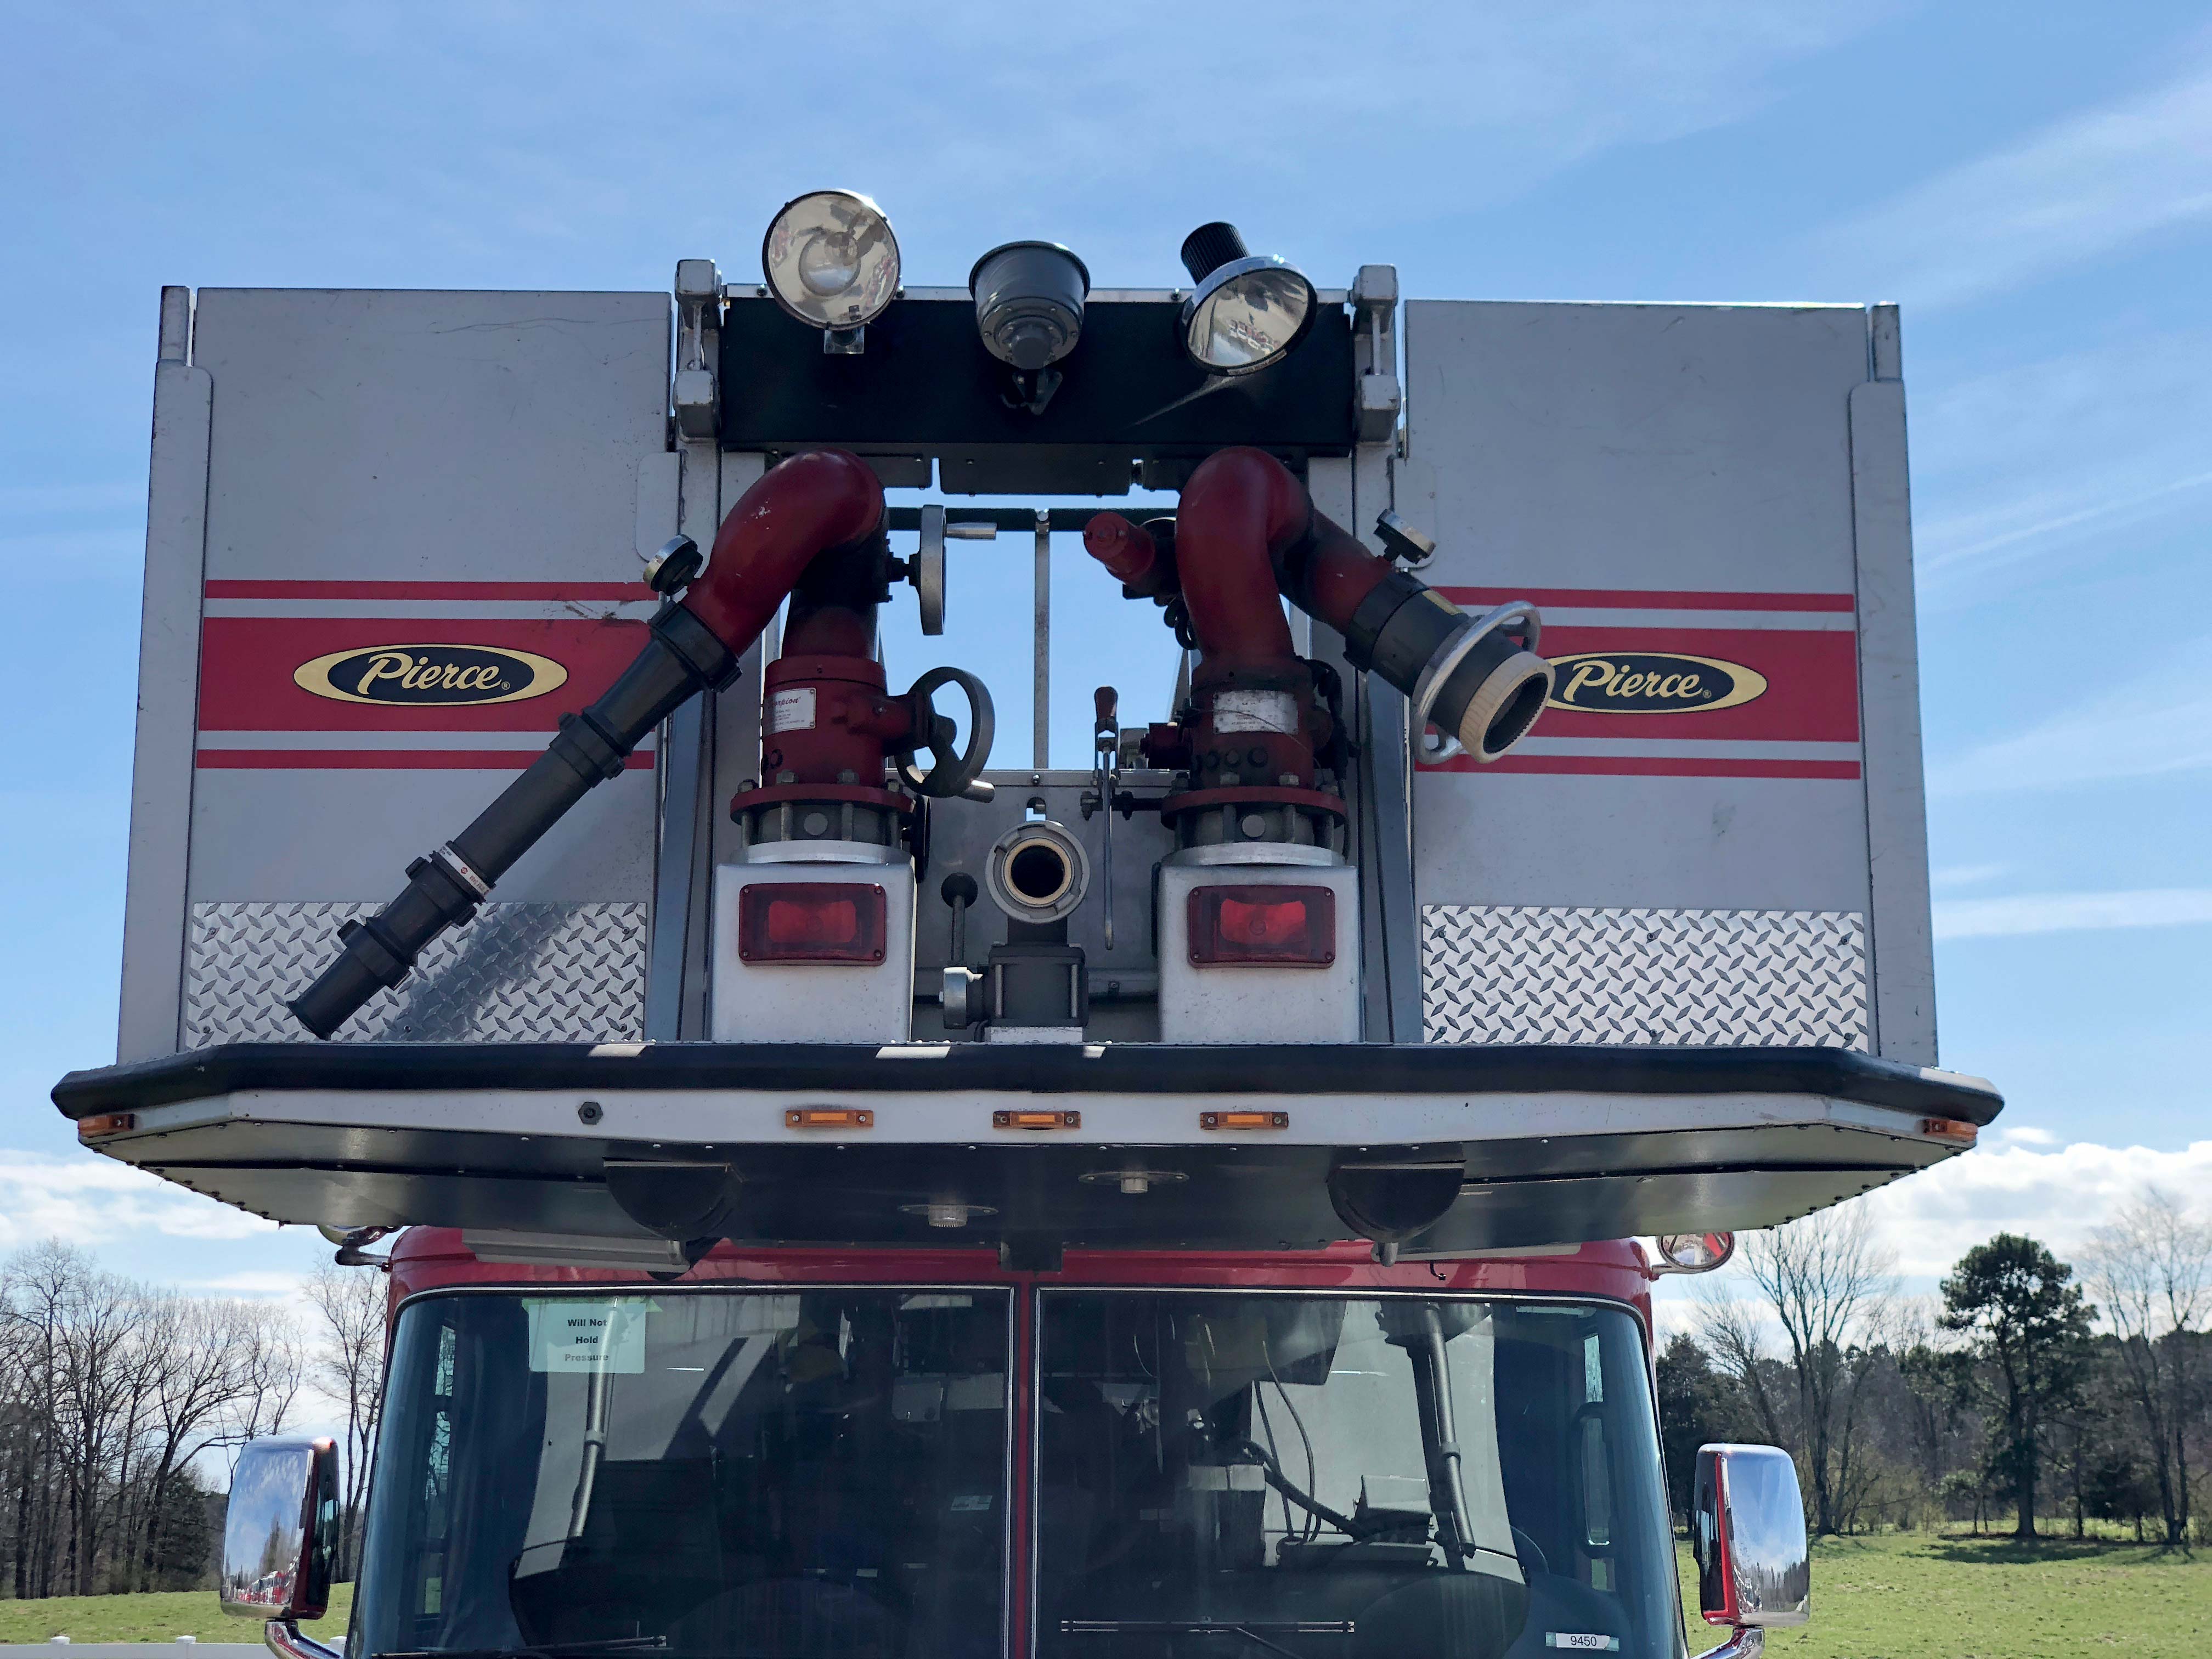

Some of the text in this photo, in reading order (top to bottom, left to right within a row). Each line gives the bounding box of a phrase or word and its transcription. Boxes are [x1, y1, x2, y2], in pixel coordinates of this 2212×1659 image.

[357, 652, 503, 695] Pierce
[1563, 660, 1703, 702] Pierce
[567, 1318, 607, 1327] Will Not
[575, 1336, 599, 1344] Hold
[565, 1353, 609, 1362] Pressure
[1570, 1635, 1597, 1646] 9450
